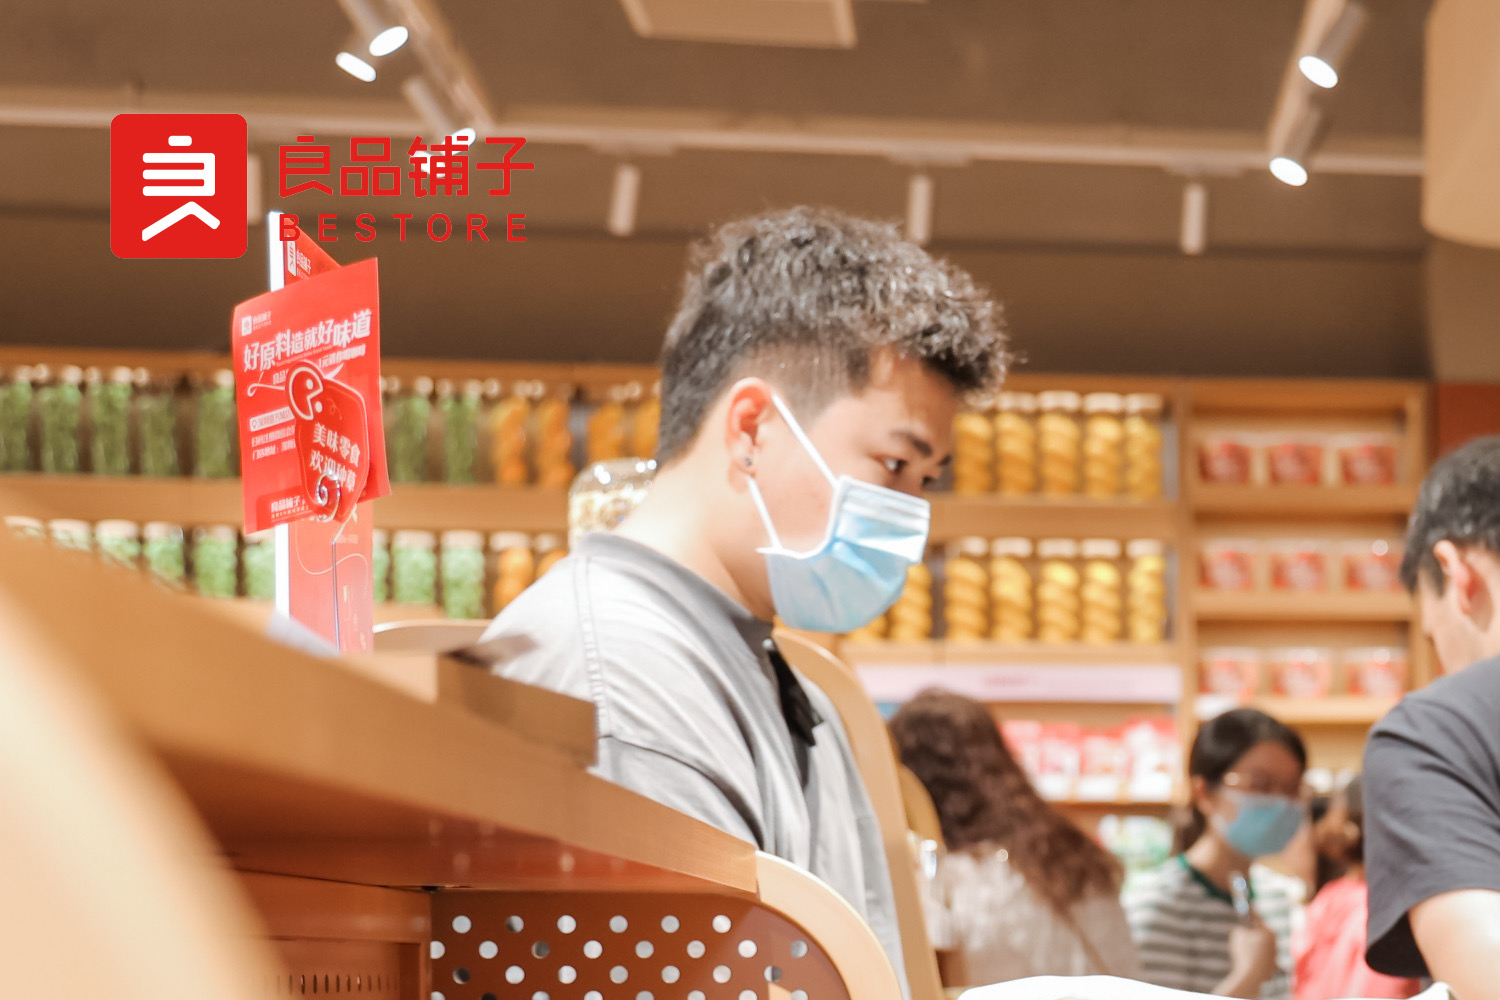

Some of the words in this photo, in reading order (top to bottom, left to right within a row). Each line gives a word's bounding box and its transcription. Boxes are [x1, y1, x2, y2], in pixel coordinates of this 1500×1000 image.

[243, 308, 372, 372] 好原料造就好味道
[312, 421, 361, 468] 美味零食
[309, 449, 357, 493] 欢迎种草
